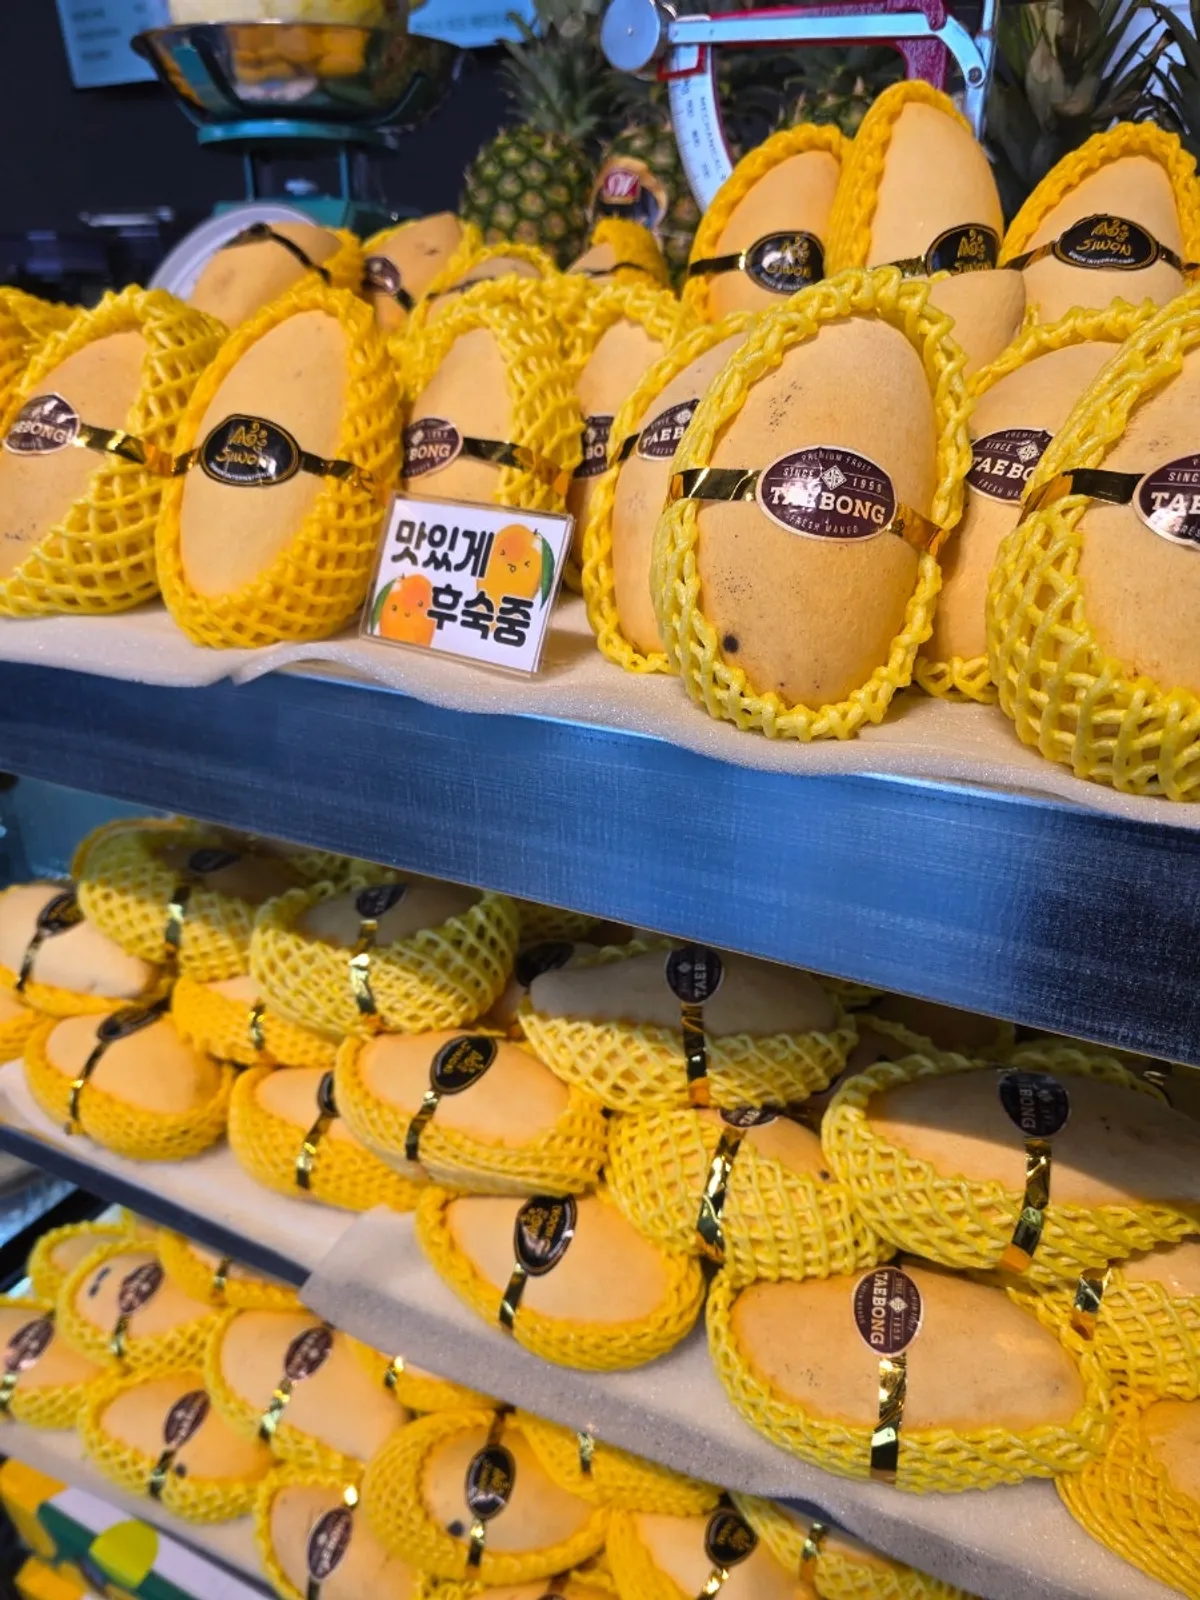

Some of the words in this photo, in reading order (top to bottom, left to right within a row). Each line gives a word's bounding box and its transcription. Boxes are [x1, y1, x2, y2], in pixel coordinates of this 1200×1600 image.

[782, 466, 815, 479] SINCE
[391, 520, 495, 578] 맛있게
[427, 583, 534, 648] 후숙중
[870, 1272, 888, 1345] TAEBONG
